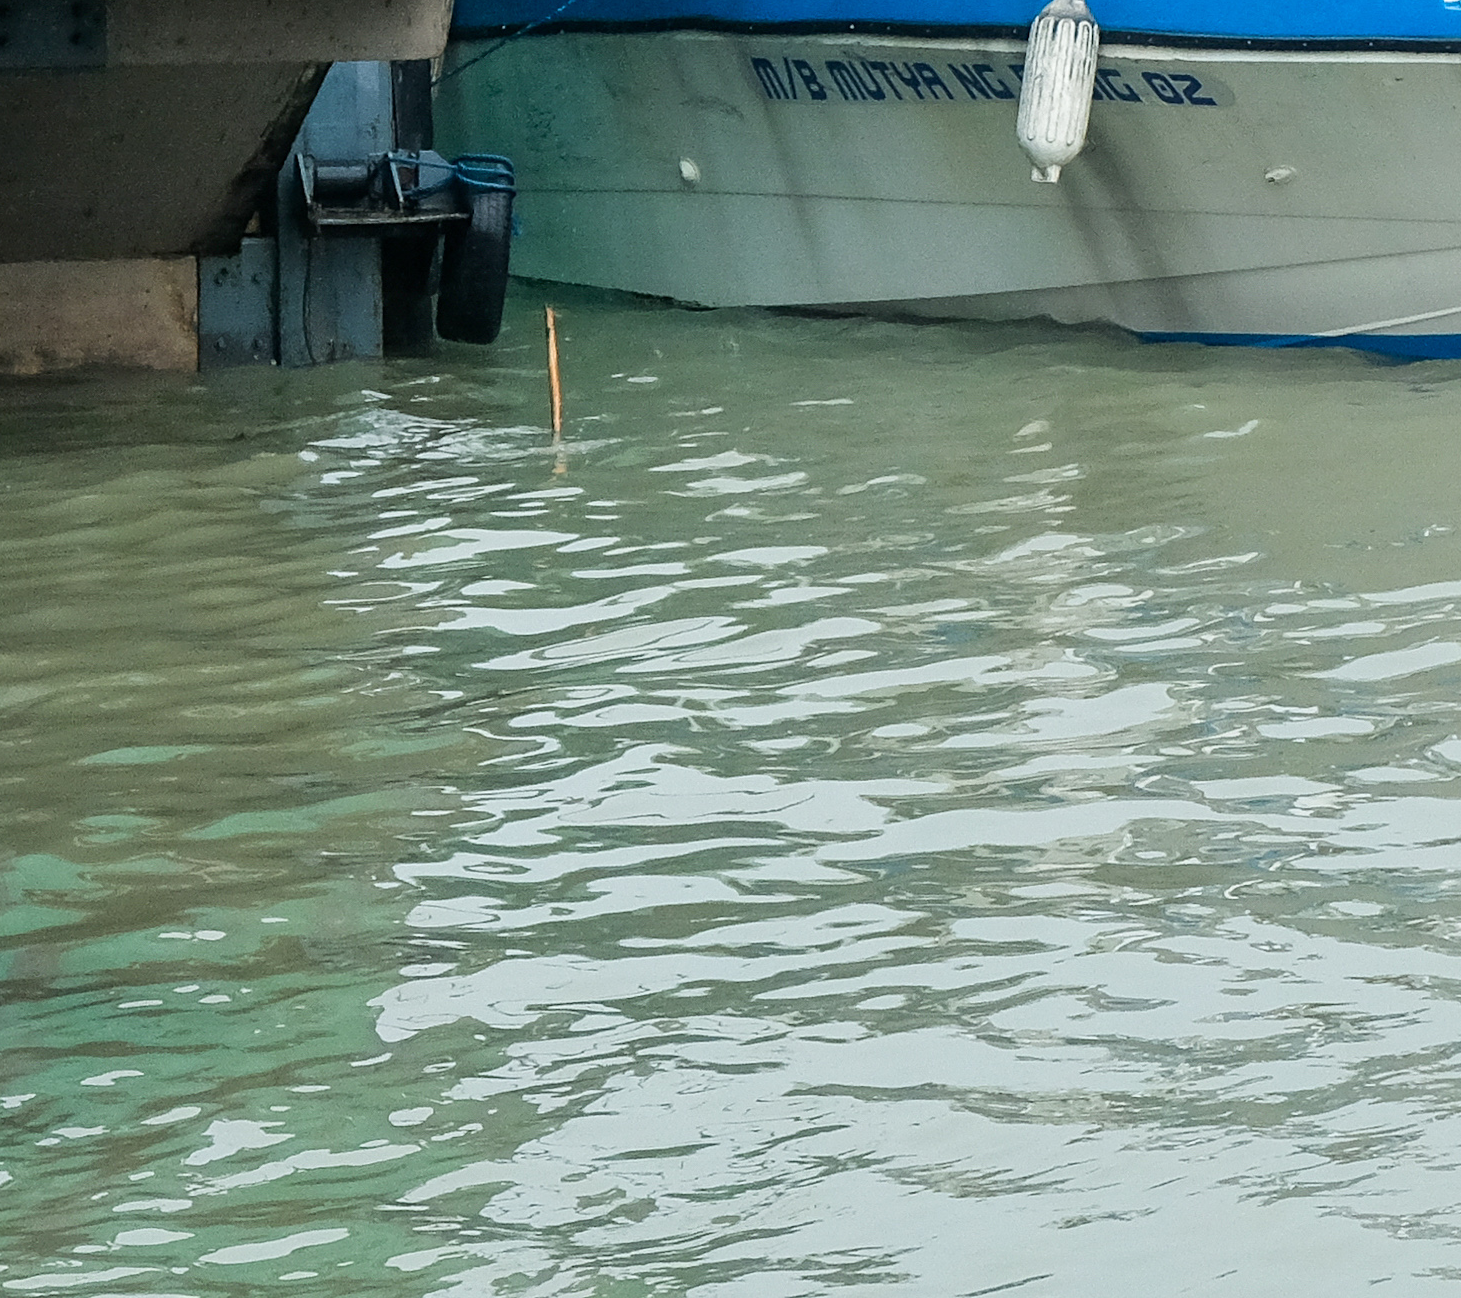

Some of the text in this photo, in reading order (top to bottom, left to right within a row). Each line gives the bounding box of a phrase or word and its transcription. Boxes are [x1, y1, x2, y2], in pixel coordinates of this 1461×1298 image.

[751, 57, 828, 102] M/B
[827, 60, 954, 102] MUTYA
[946, 62, 1017, 101] NG
[1141, 71, 1218, 107] 02
